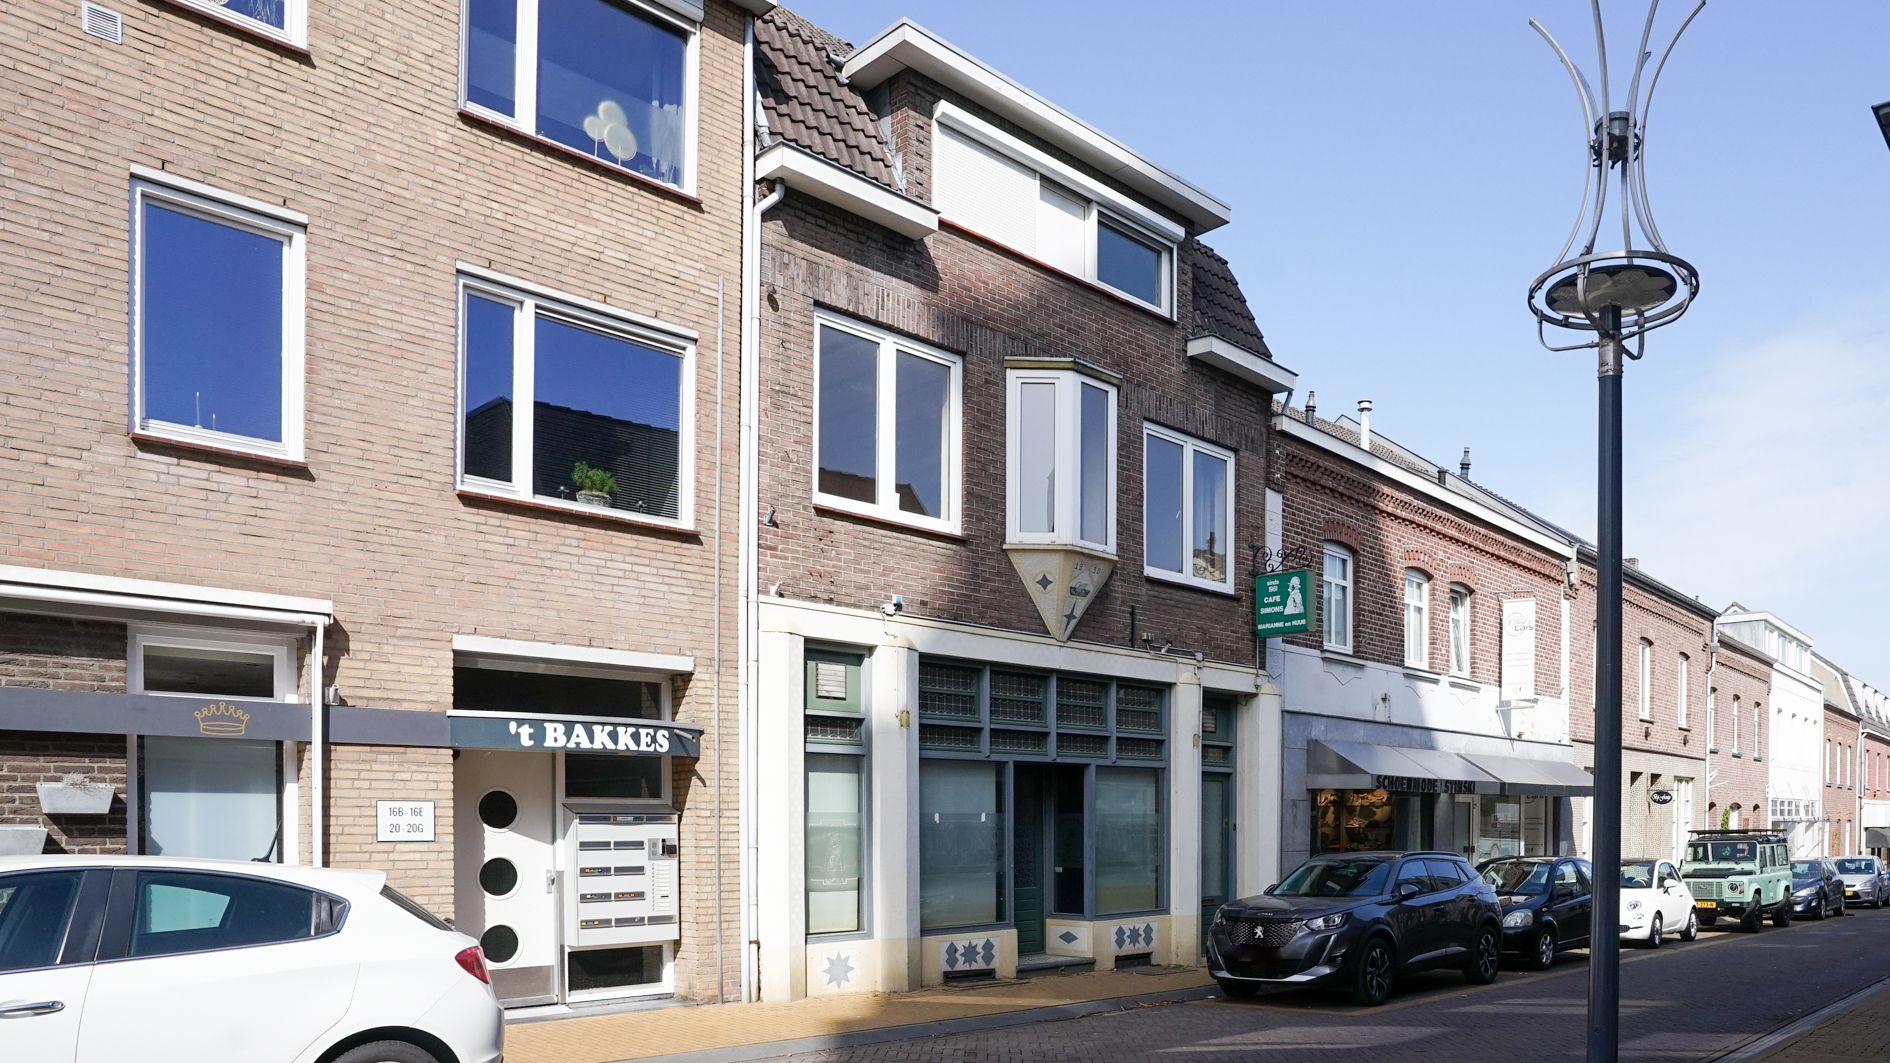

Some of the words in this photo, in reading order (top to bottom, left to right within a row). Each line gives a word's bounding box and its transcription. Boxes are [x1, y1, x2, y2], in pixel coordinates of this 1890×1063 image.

[1260, 606, 1284, 614] SIMONS
[1257, 622, 1285, 630] MARIANNE
[508, 721, 534, 747] 't
[543, 722, 670, 753] BAKKES
[389, 807, 404, 817] 16B
[410, 807, 424, 817] 16E
[389, 823, 400, 833] 20
[407, 823, 424, 833] 20G
